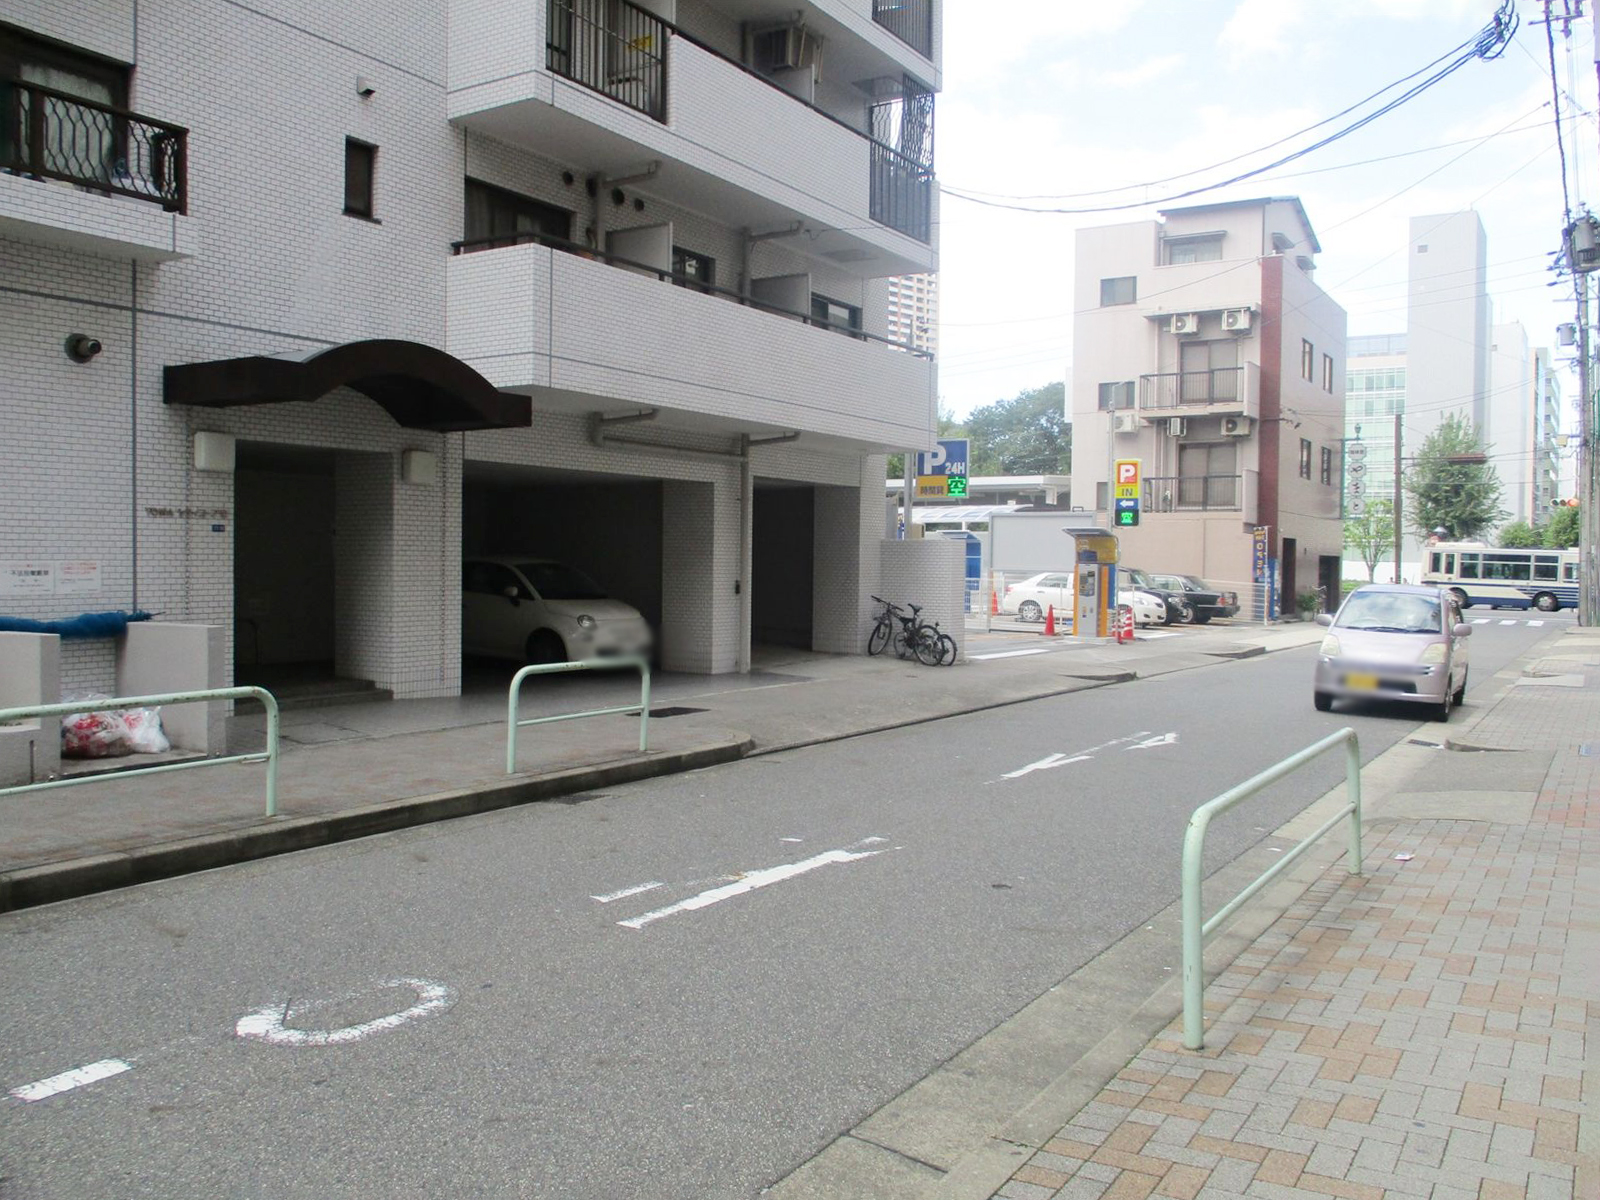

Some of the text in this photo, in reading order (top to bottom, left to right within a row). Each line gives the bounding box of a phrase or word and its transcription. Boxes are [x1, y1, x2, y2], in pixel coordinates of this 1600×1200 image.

[924, 444, 965, 474] P 24H
[1120, 464, 1136, 483] P
[948, 477, 966, 496] 空
[1122, 488, 1133, 496] IN
